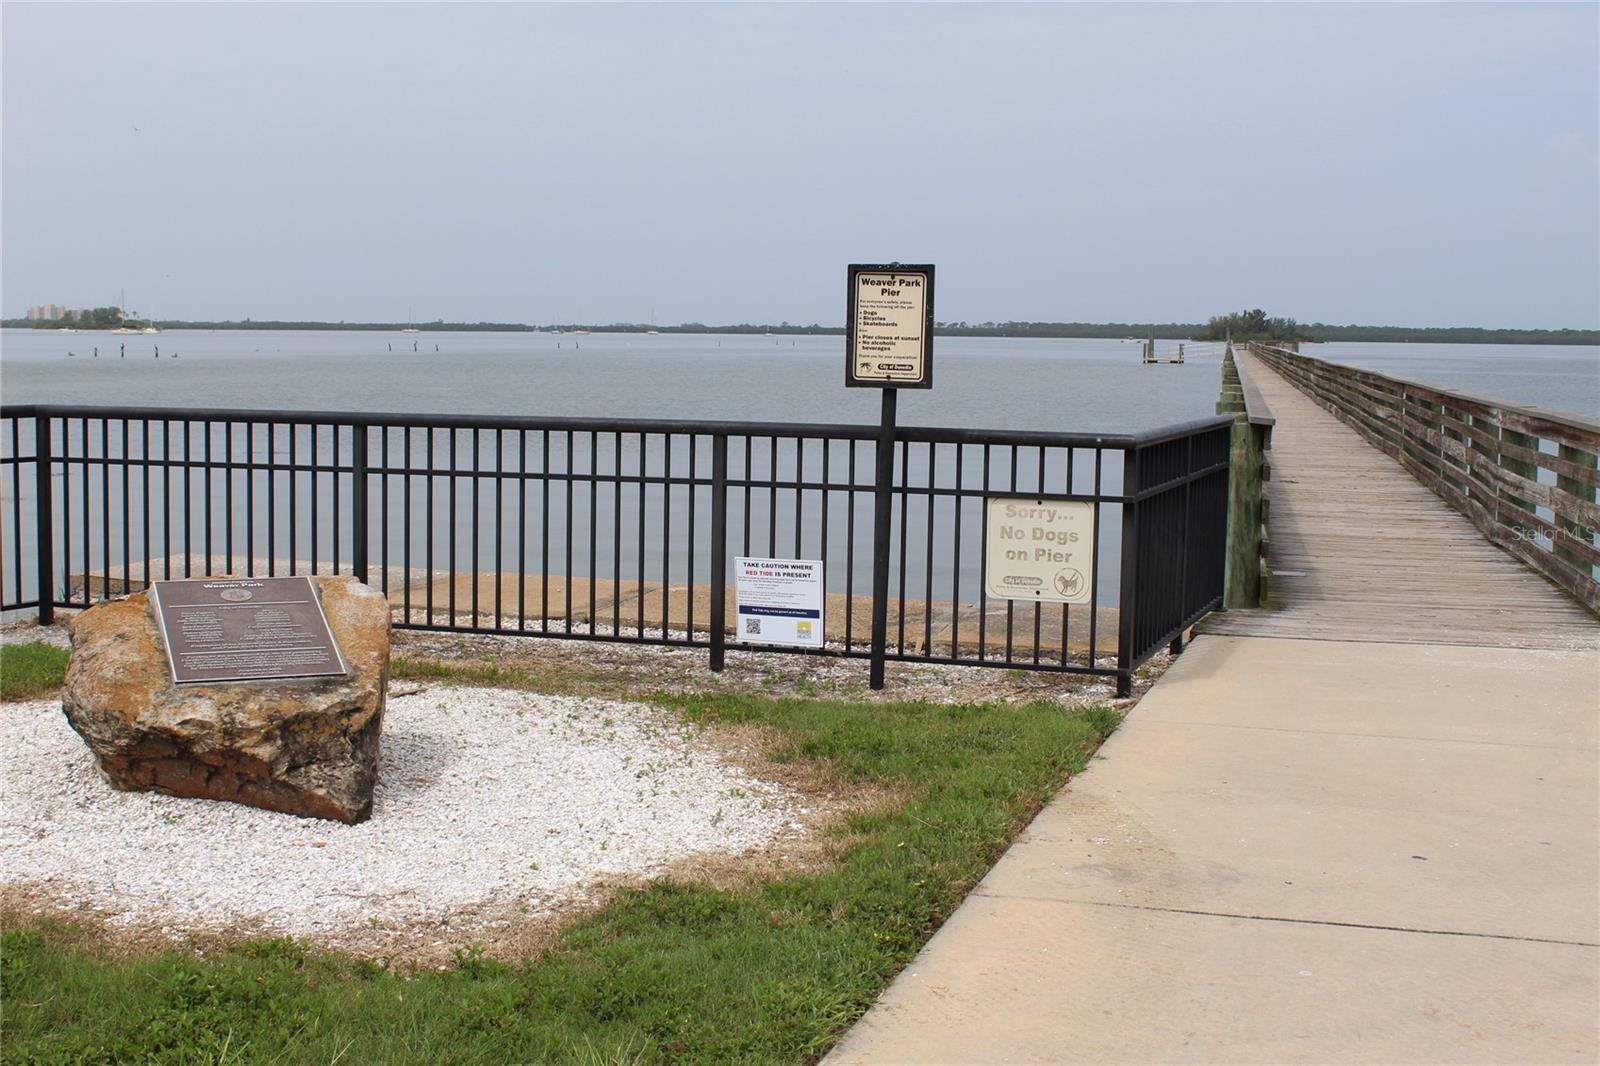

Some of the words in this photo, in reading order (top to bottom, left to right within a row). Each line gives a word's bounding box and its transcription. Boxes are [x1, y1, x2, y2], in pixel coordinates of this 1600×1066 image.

[861, 278, 897, 287] Weaver
[899, 279, 921, 288] Park
[881, 288, 901, 297] Pier
[1005, 504, 1075, 523] Sorry...
[1000, 526, 1025, 540] No
[1032, 527, 1079, 545] Dogs
[1006, 550, 1028, 561] on
[1034, 548, 1073, 563] Pier
